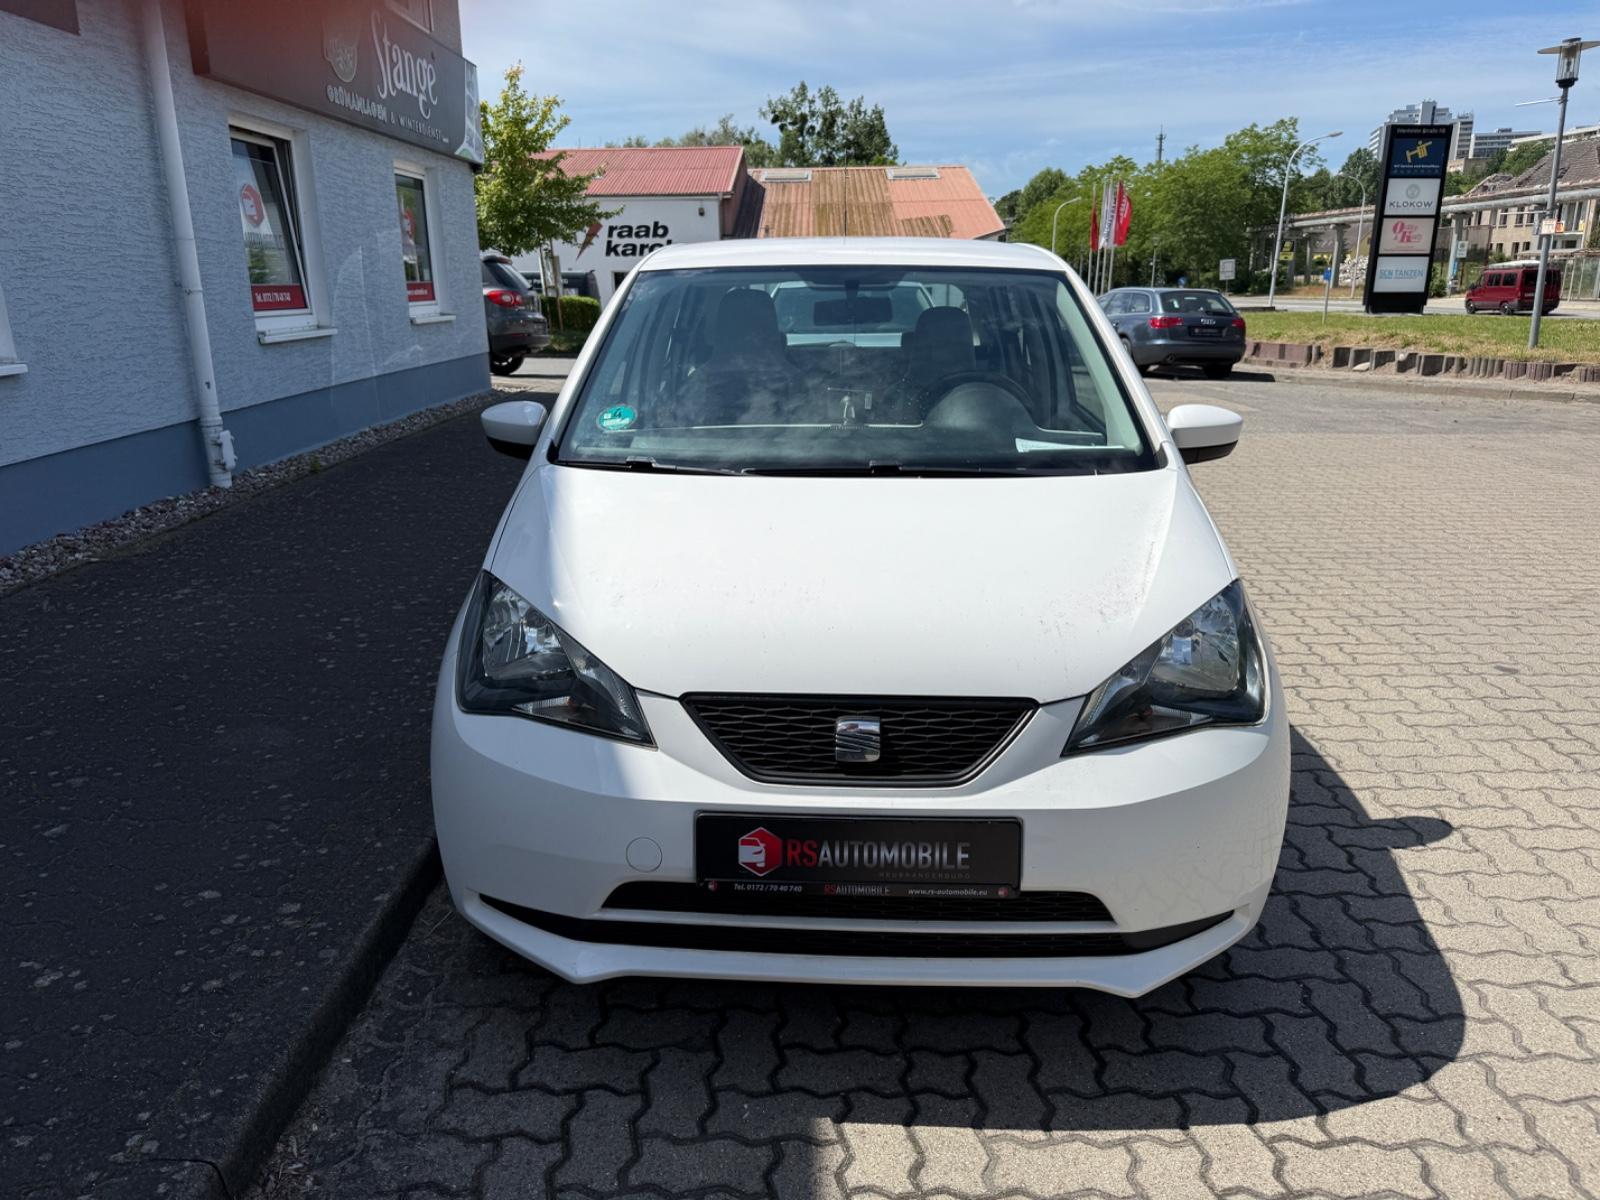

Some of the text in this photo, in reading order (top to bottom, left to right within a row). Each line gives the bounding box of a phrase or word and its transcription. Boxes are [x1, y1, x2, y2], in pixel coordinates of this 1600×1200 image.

[371, 10, 438, 119] Stange
[1388, 200, 1433, 208] KLOKOW
[607, 220, 669, 239] raab
[734, 883, 746, 891] Tel.
[908, 888, 988, 896] www.rs-automobile.eu
